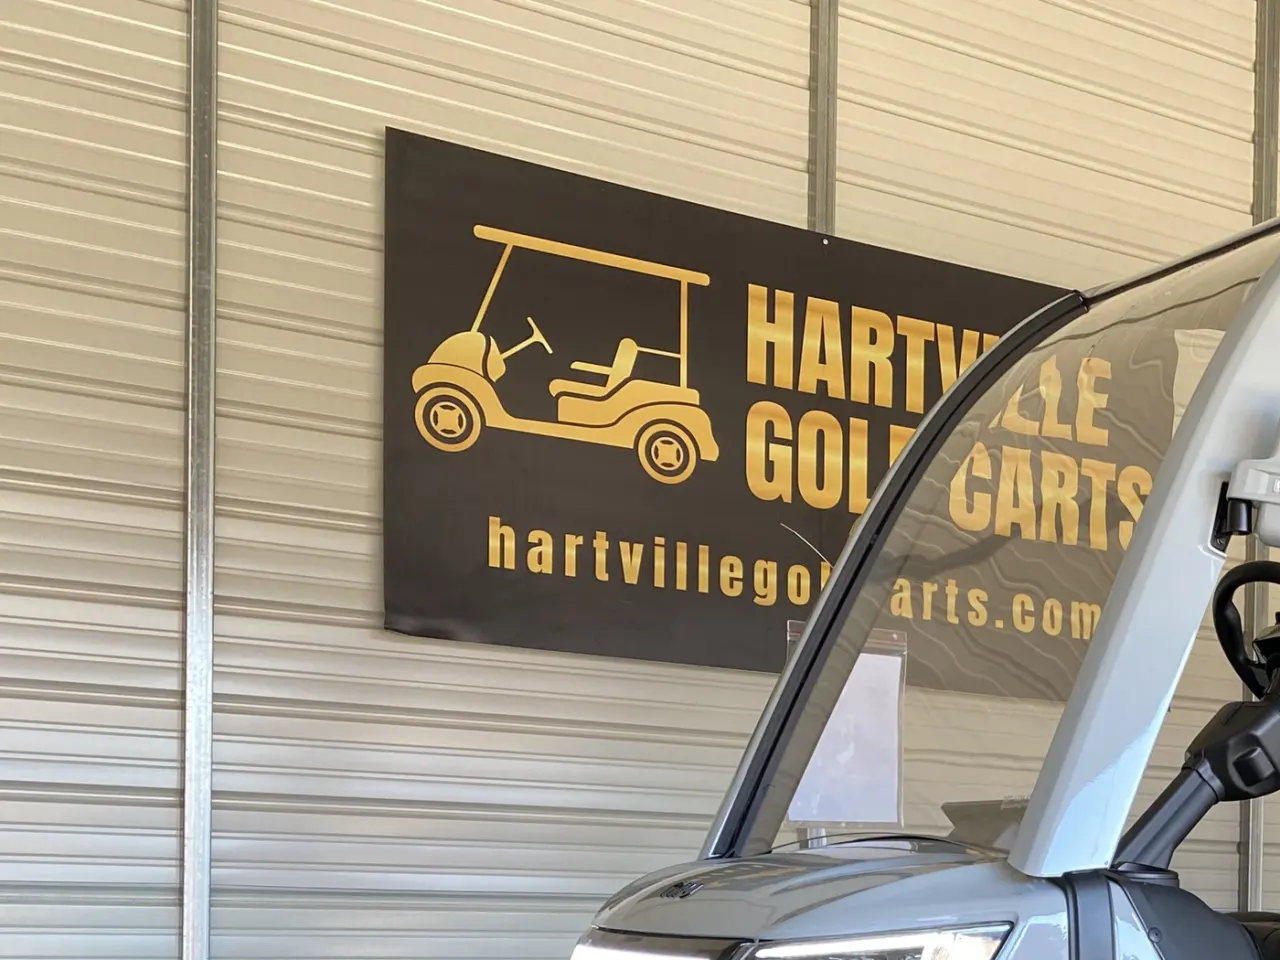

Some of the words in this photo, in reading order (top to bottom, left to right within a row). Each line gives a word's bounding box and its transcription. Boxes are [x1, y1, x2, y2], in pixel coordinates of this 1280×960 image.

[747, 283, 1112, 447] HARTVLLE
[745, 400, 918, 515] GOL
[949, 441, 1153, 551] CARTS
